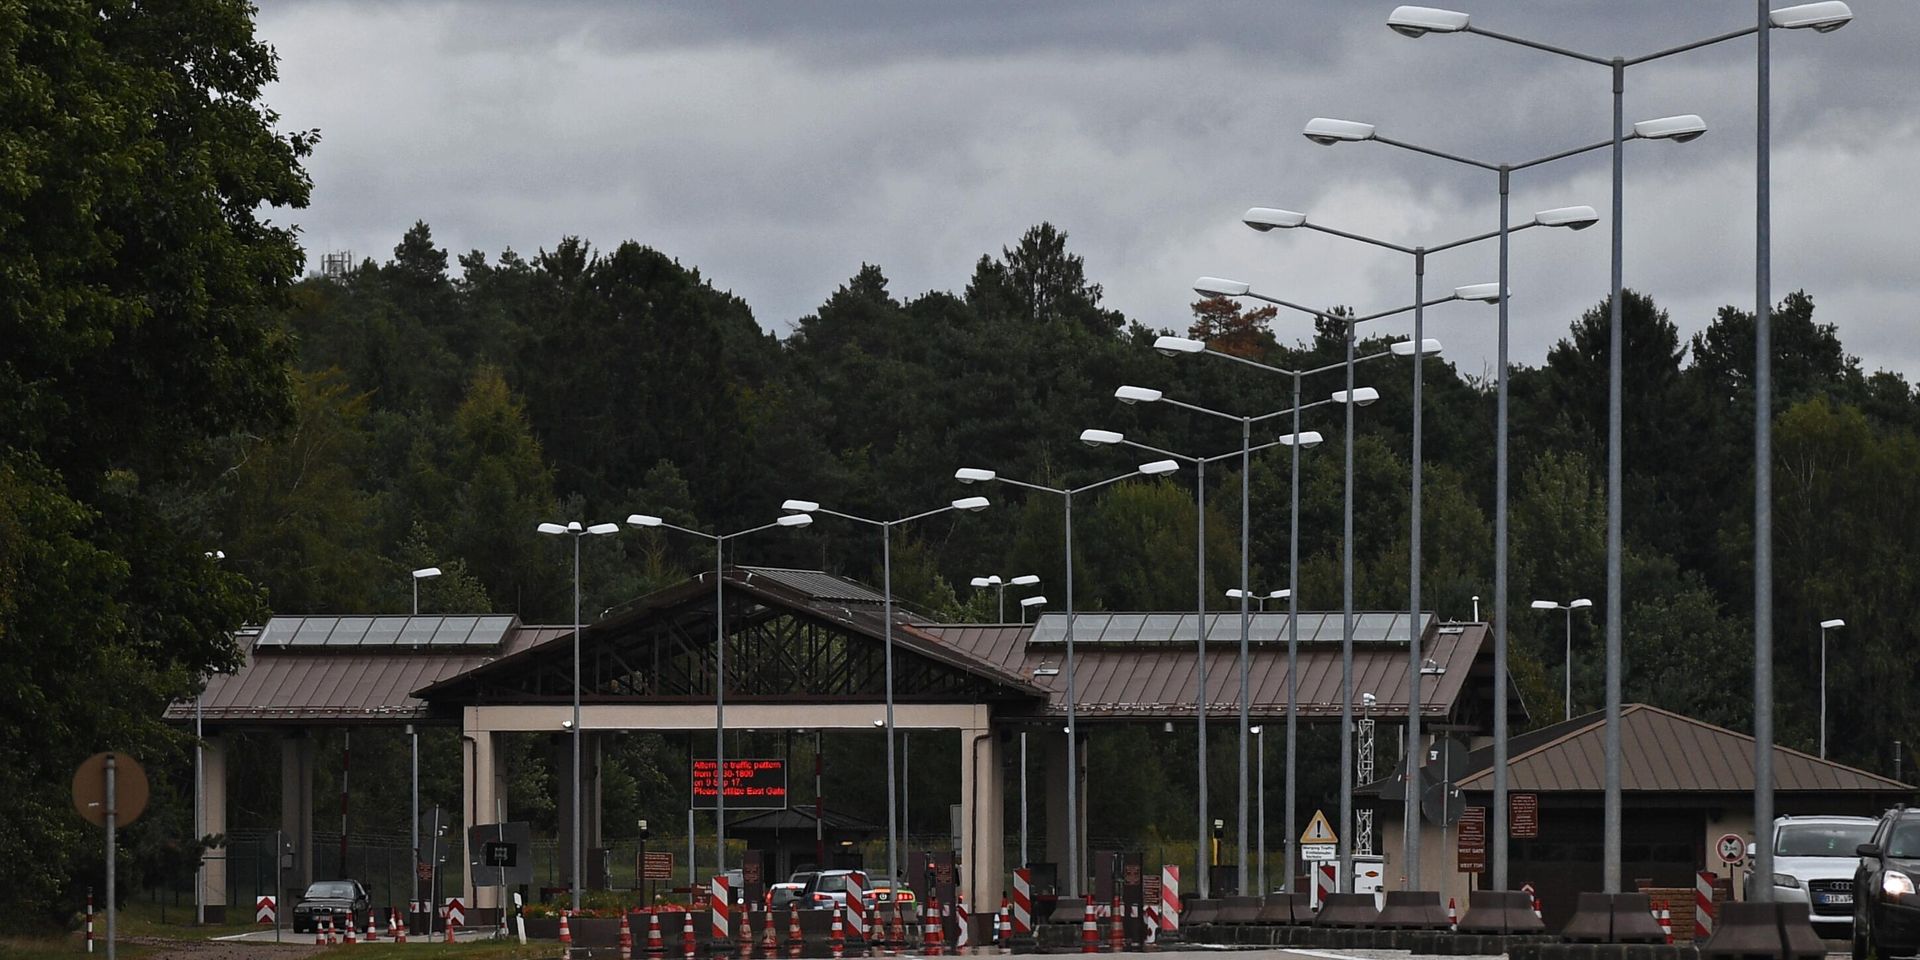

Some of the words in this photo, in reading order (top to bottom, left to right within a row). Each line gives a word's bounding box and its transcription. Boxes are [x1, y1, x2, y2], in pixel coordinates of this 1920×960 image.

[730, 760, 752, 768] traffic
[754, 761, 781, 770] pattern
[713, 778, 728, 787] Sp
[746, 787, 764, 795] East
[766, 787, 785, 795] Gate
